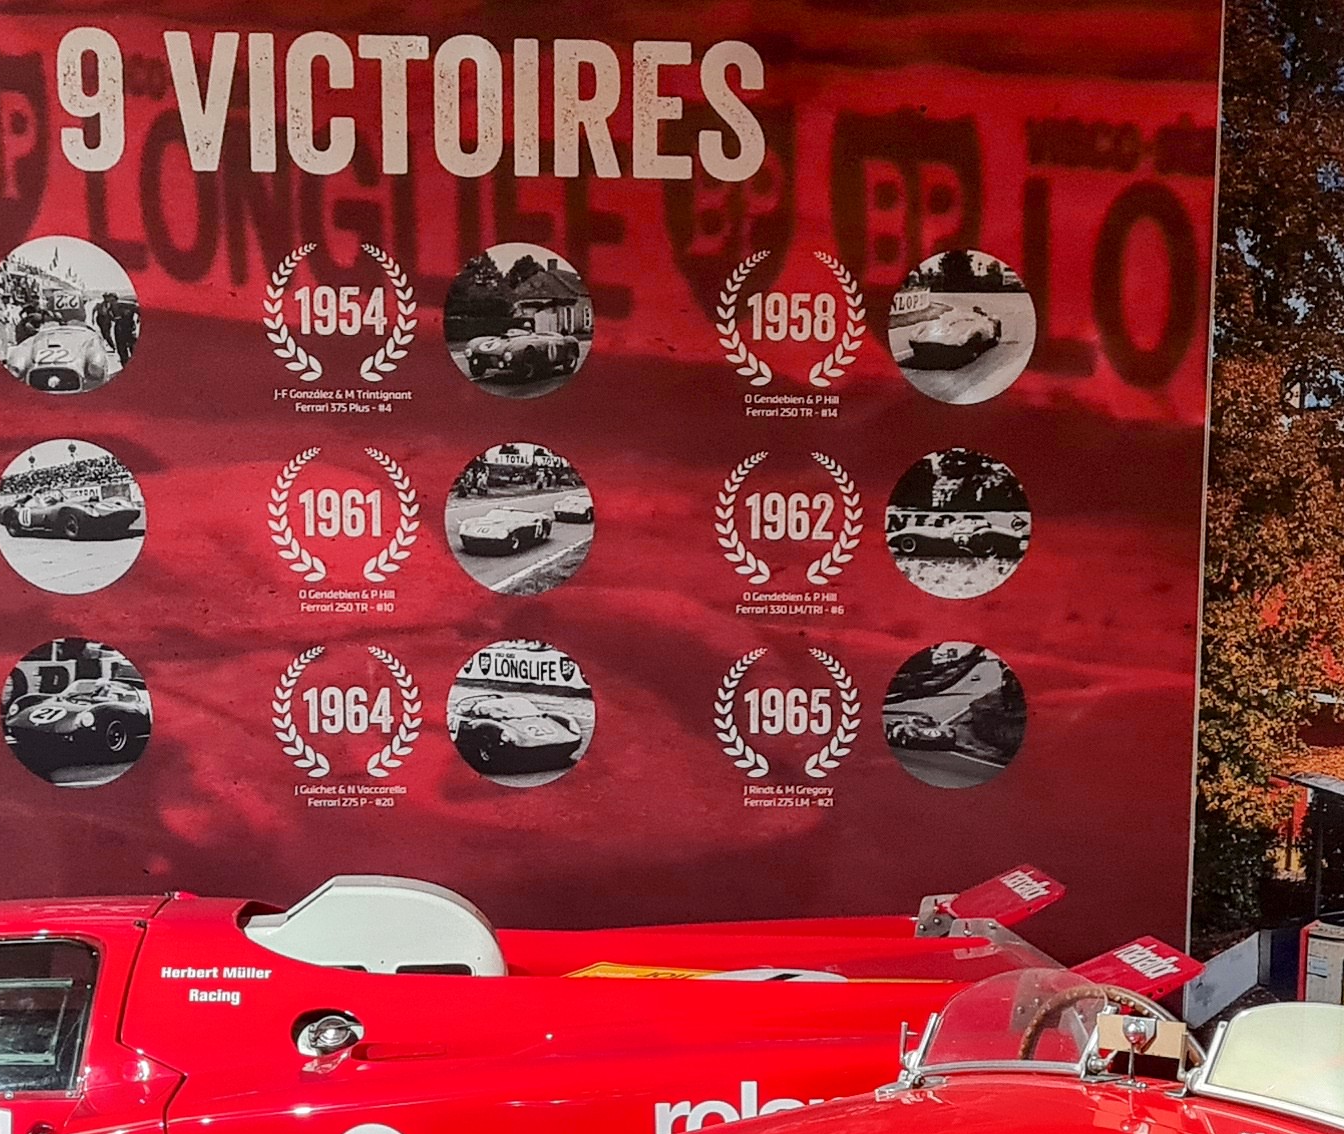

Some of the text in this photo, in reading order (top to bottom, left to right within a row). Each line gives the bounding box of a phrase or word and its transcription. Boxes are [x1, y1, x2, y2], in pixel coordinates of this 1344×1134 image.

[57, 27, 765, 182] 9 VICTOIRES
[294, 286, 387, 337] 1954
[746, 292, 837, 342] 1958
[38, 348, 74, 365] 22
[273, 388, 413, 402] J-F González & M Trintignant
[753, 393, 806, 405] Gendebien
[805, 393, 815, 405] &
[815, 393, 823, 405] P
[823, 393, 840, 405] Hill
[294, 402, 330, 413] Ferrari
[330, 402, 348, 413] 375
[348, 402, 370, 413] Plus
[377, 402, 393, 413] #4
[745, 407, 780, 418] Ferrari
[779, 407, 799, 418] 250
[799, 407, 814, 418] TR
[820, 407, 839, 418] #14
[298, 488, 383, 538] 1961
[744, 491, 835, 542] 1962
[307, 589, 361, 600] Gendebien
[360, 589, 370, 600] &
[370, 589, 378, 600] P
[378, 589, 396, 600] Hill
[751, 592, 804, 602] Gendebien
[803, 592, 813, 602] &
[812, 592, 821, 602] P
[299, 602, 335, 613] Ferrari
[334, 602, 354, 613] 250
[354, 602, 369, 613] TR
[375, 602, 395, 613] #10
[734, 604, 769, 615] Ferrari
[768, 604, 788, 615] 330
[830, 604, 845, 615] #6
[494, 657, 557, 682] LONGLIFE
[301, 686, 394, 734] 1964
[743, 687, 833, 736] 1965
[298, 785, 337, 796] Guichet
[336, 785, 346, 796] &
[347, 785, 356, 796] N
[355, 785, 408, 796] Vaccarella
[748, 785, 775, 797] Rindt
[775, 785, 784, 797] &
[784, 785, 795, 797] M
[795, 785, 834, 797] Gregory
[306, 797, 342, 807] Ferrari
[341, 797, 359, 807] 275
[359, 797, 368, 807] P
[374, 797, 395, 807] #20
[742, 797, 777, 807] Ferrari
[776, 797, 795, 807] 275
[794, 797, 811, 807] LM
[816, 797, 835, 807] #21
[161, 966, 272, 979] Herbert Müller
[189, 988, 241, 1006] Racing
